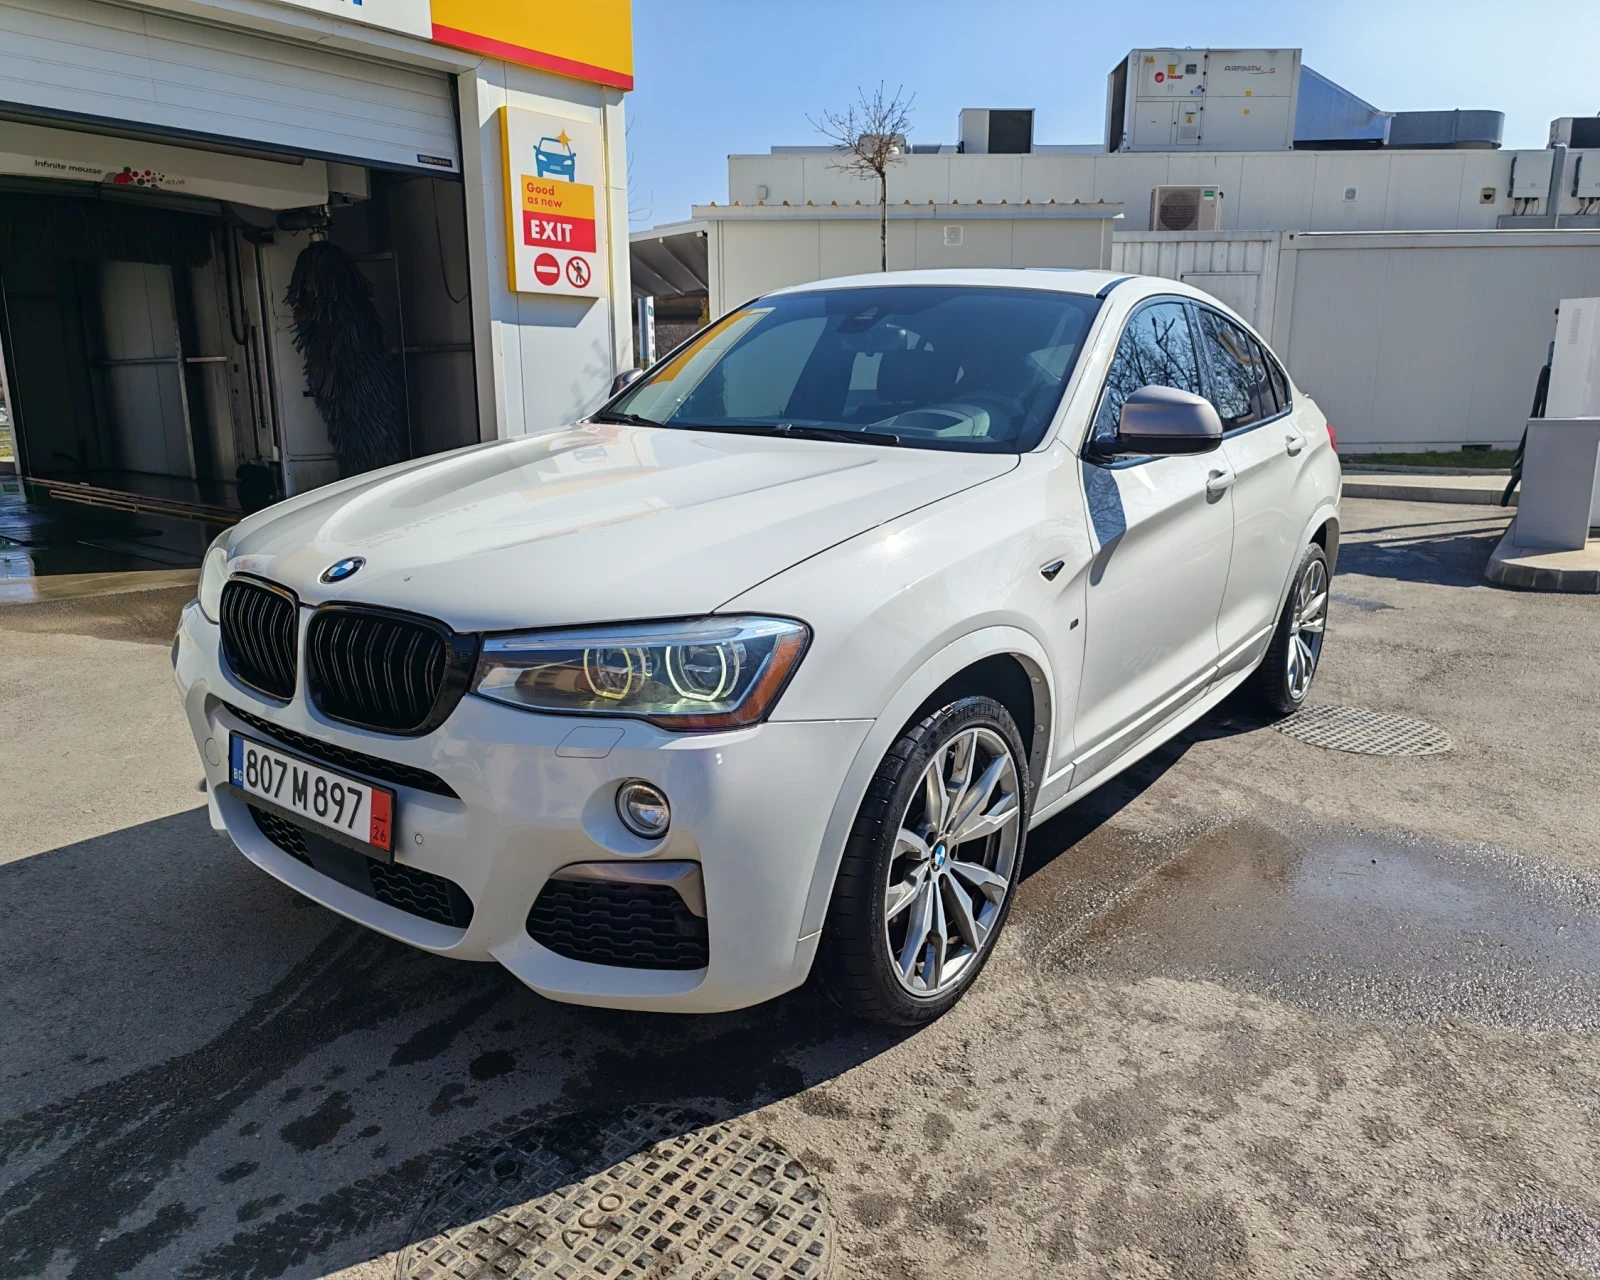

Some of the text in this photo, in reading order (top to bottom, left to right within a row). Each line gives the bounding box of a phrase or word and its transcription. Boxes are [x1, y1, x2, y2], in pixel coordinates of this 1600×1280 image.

[34, 159, 103, 175] Infinite mousse
[526, 182, 555, 197] Good
[527, 196, 563, 208] as new
[530, 219, 573, 243] EXIT
[233, 767, 243, 781] BG
[246, 749, 363, 830] 807 M 897
[372, 824, 387, 843] 26
[561, 1192, 624, 1250] ACO
[683, 1215, 724, 1251] D400
